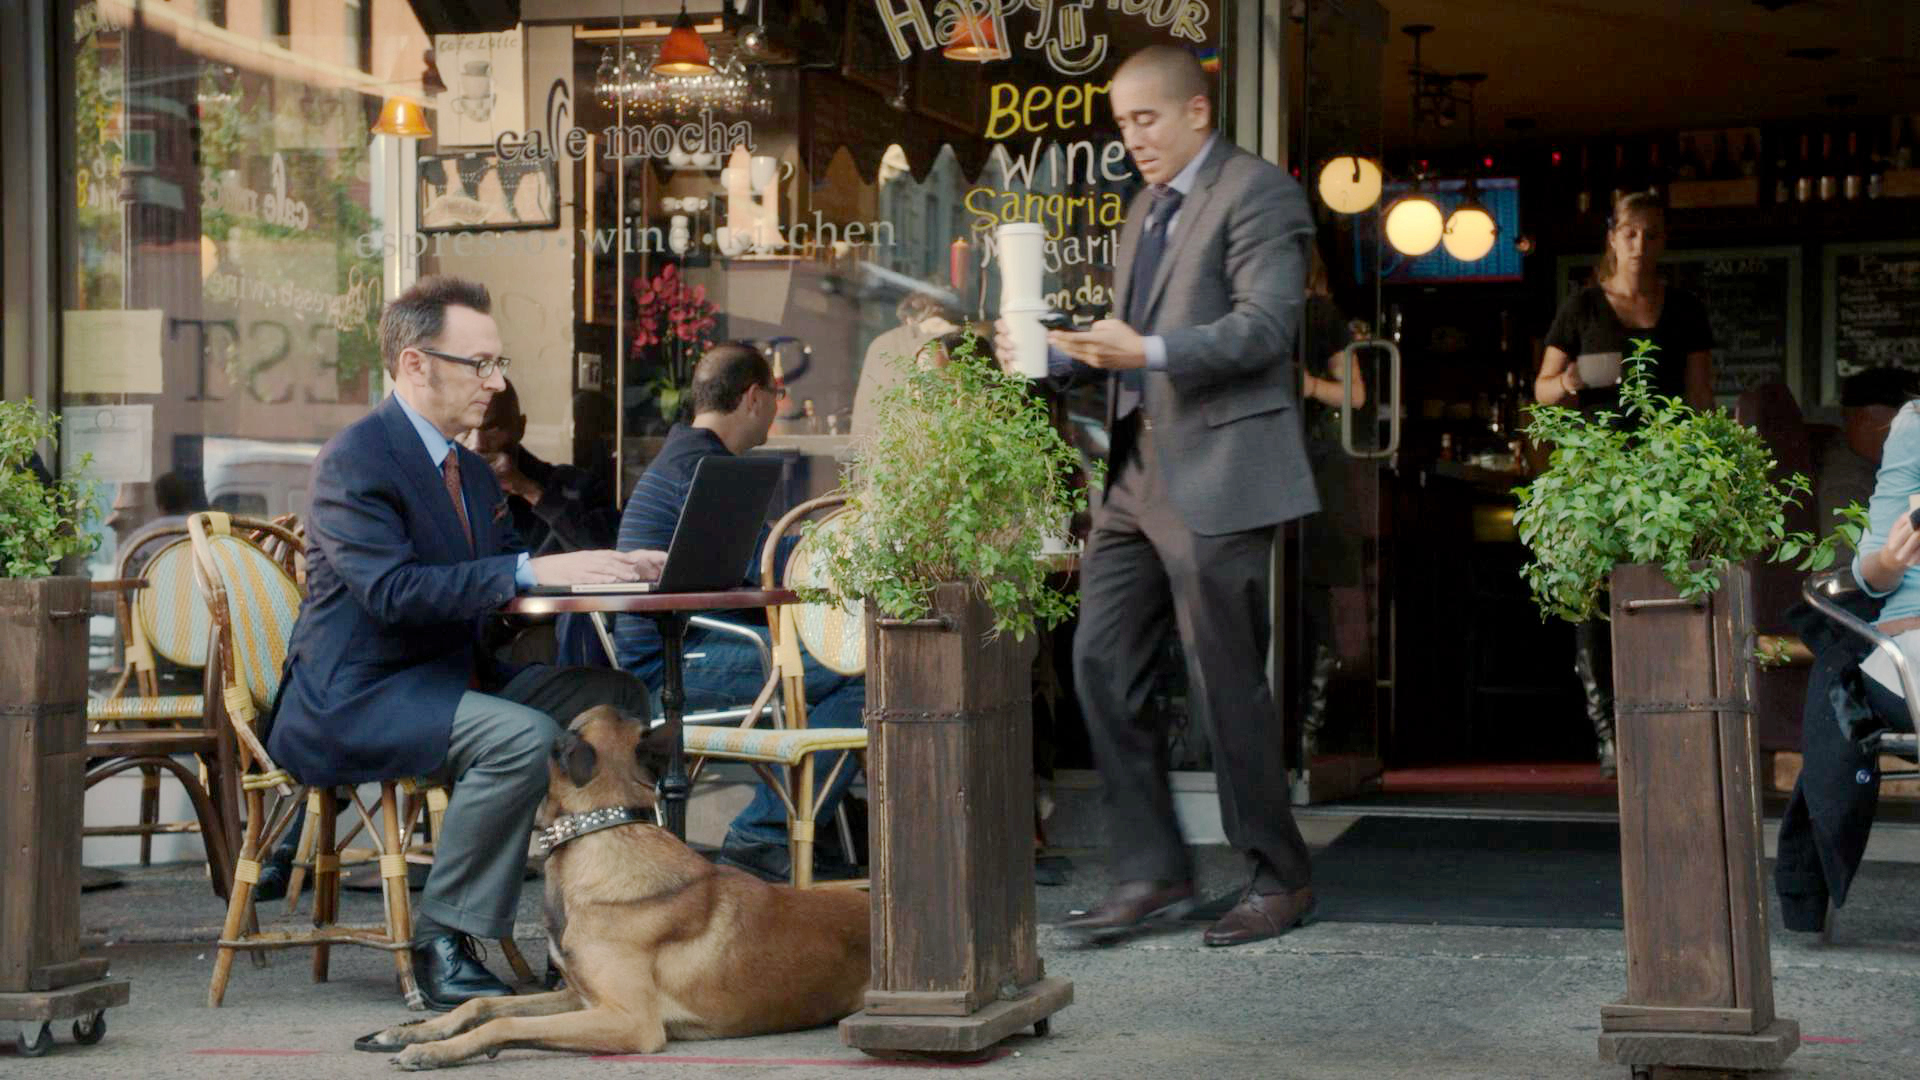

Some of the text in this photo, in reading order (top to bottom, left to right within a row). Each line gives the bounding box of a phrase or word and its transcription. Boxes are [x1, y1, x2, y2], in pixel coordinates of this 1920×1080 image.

[495, 78, 757, 162] cafe mocha
[984, 80, 1114, 139] Beer
[999, 136, 1133, 191] Wine
[964, 187, 1128, 241] Sangria
[354, 230, 547, 270] espresso
[580, 215, 688, 255] win
[1044, 274, 1115, 310] onda
